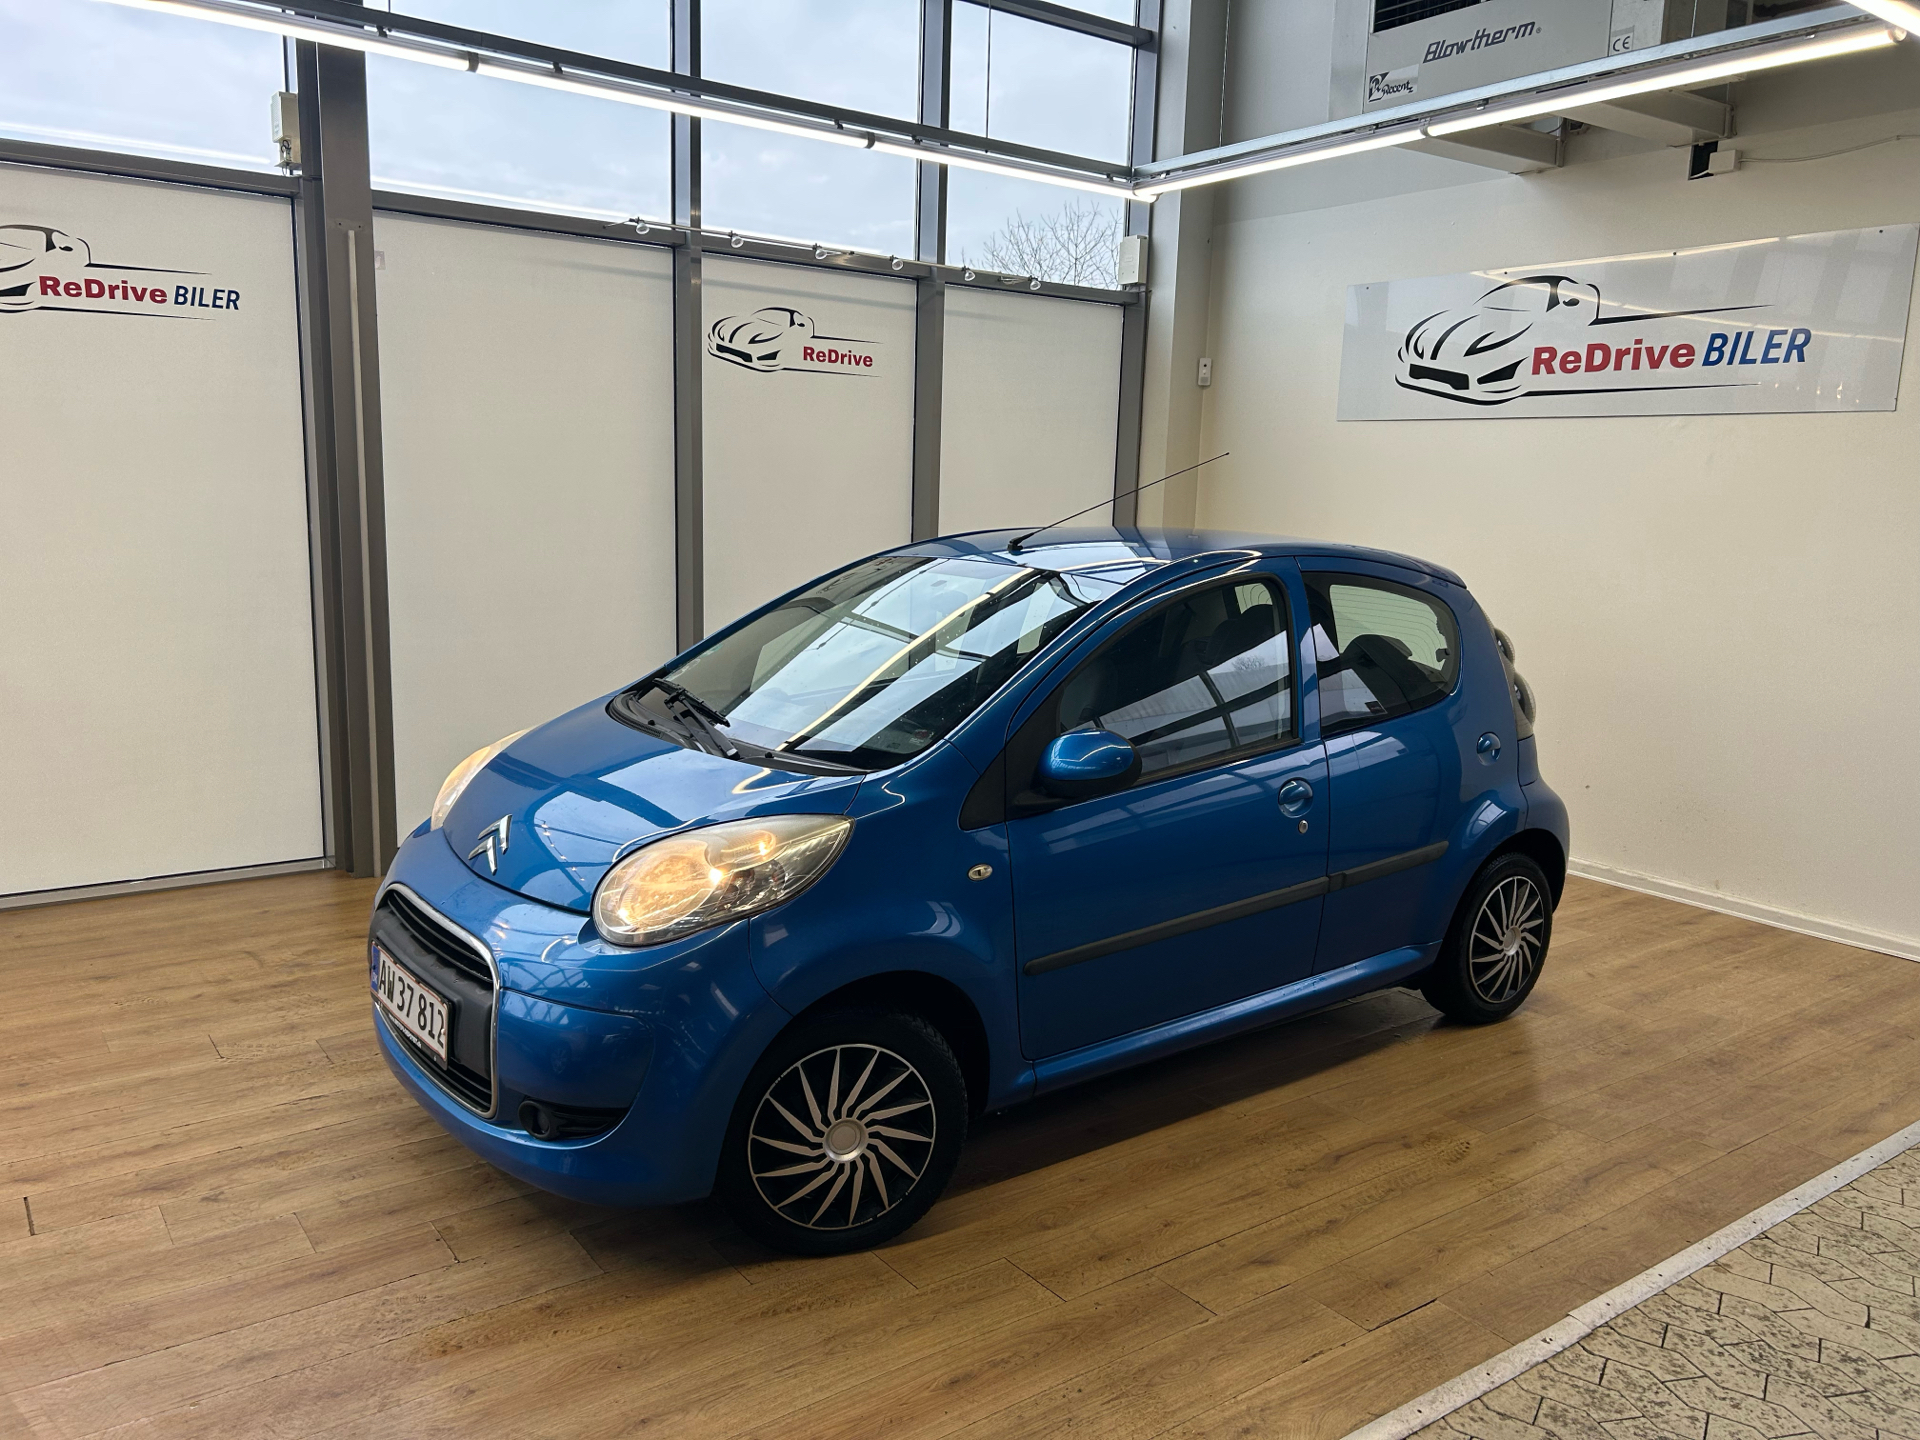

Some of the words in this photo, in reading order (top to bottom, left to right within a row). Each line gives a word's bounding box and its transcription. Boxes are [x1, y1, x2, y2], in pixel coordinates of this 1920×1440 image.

[1422, 21, 1536, 64] Blowtherm
[38, 275, 168, 304] ReDrive
[173, 285, 241, 311] BILER
[803, 346, 873, 367] ReDrive
[1531, 338, 1696, 376] ReDrive
[1701, 328, 1812, 367] BILER
[379, 959, 395, 1004] AW
[397, 975, 415, 1019] 37
[418, 992, 446, 1049] 812
